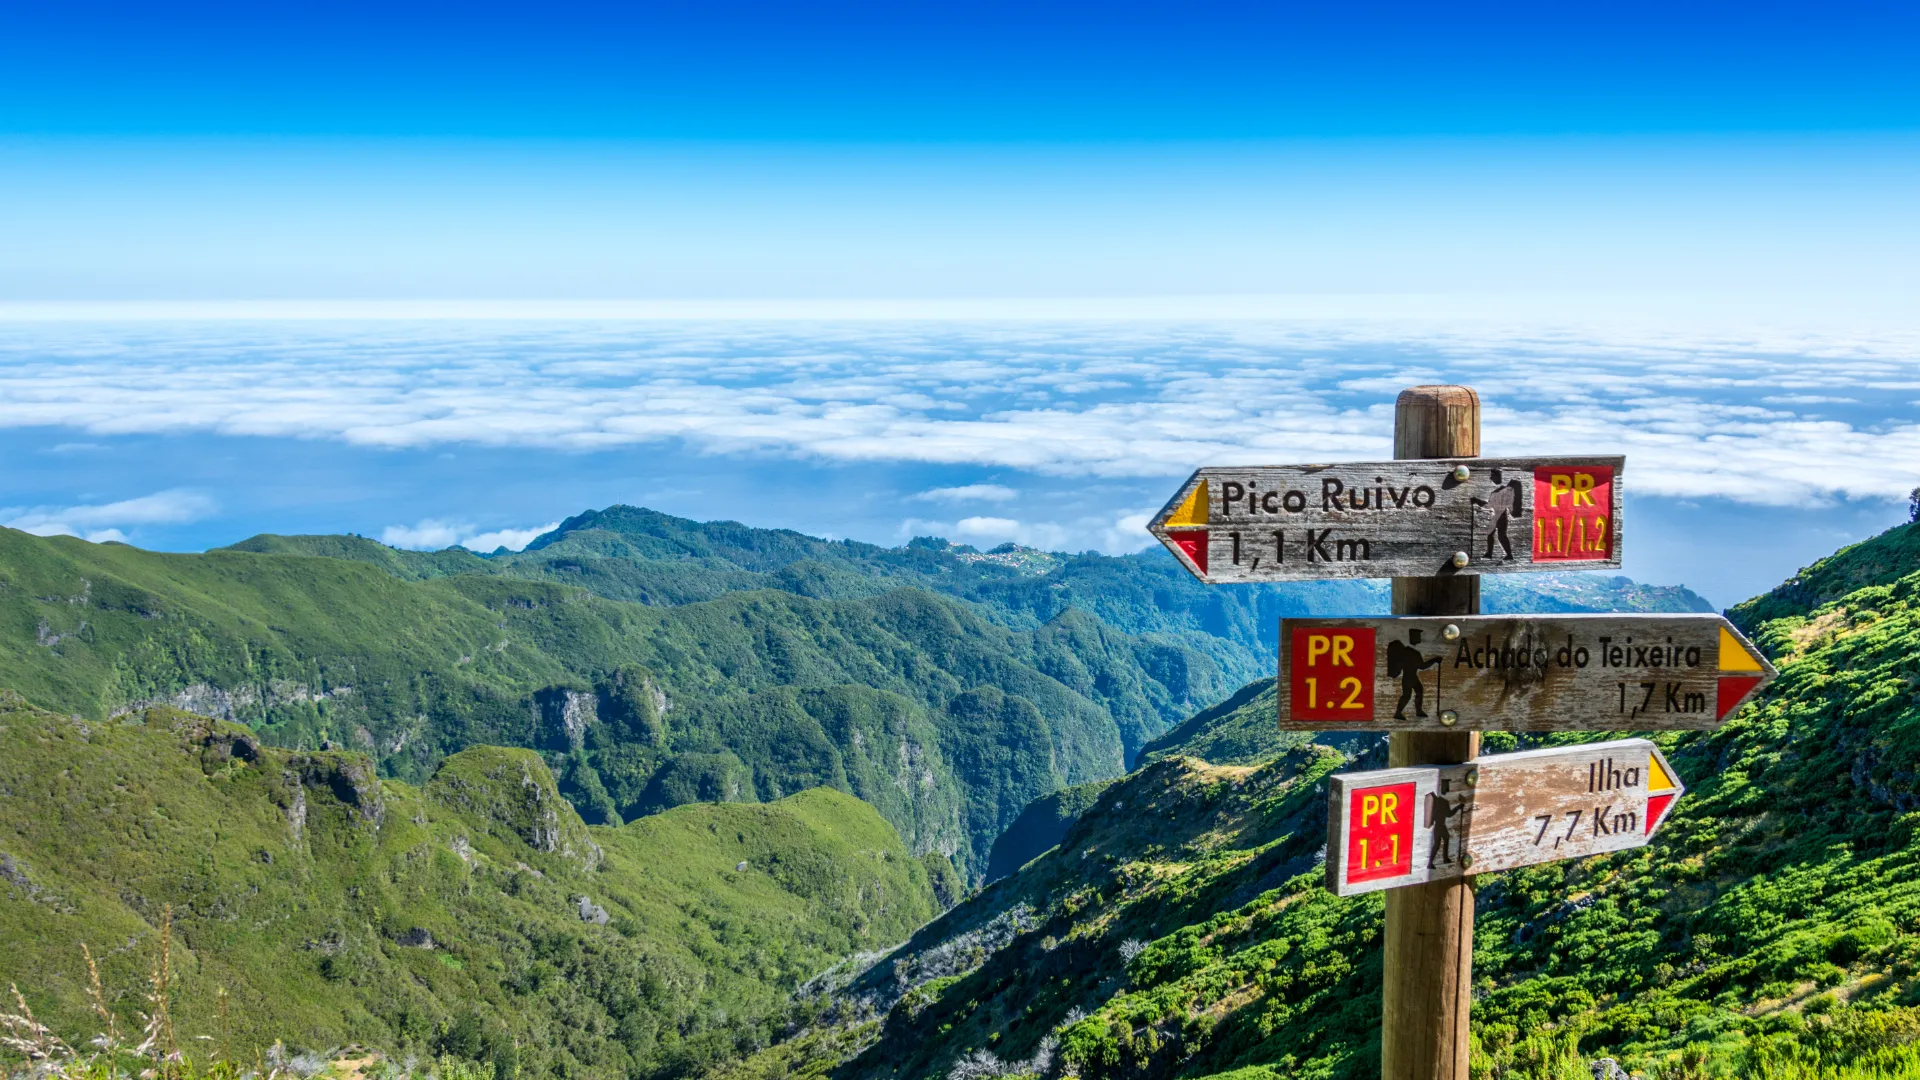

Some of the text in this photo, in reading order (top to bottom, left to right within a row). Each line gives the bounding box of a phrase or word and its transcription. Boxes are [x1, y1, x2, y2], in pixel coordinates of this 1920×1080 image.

[1222, 476, 1436, 516] Pico Ruivo
[1550, 472, 1596, 507] PR
[1227, 527, 1370, 572] 1,1 Km
[1537, 514, 1608, 556] 1.1/1.2
[1307, 634, 1356, 668] PR
[1556, 633, 1590, 669] do
[1600, 635, 1702, 668] Teixeira
[1304, 676, 1365, 710] 1.2
[1617, 681, 1706, 719] 1,7 Km
[1588, 757, 1640, 793] Ilha
[1361, 791, 1399, 828] PR
[1534, 805, 1636, 850] 7,7 Km
[1359, 833, 1400, 871] 1.1
